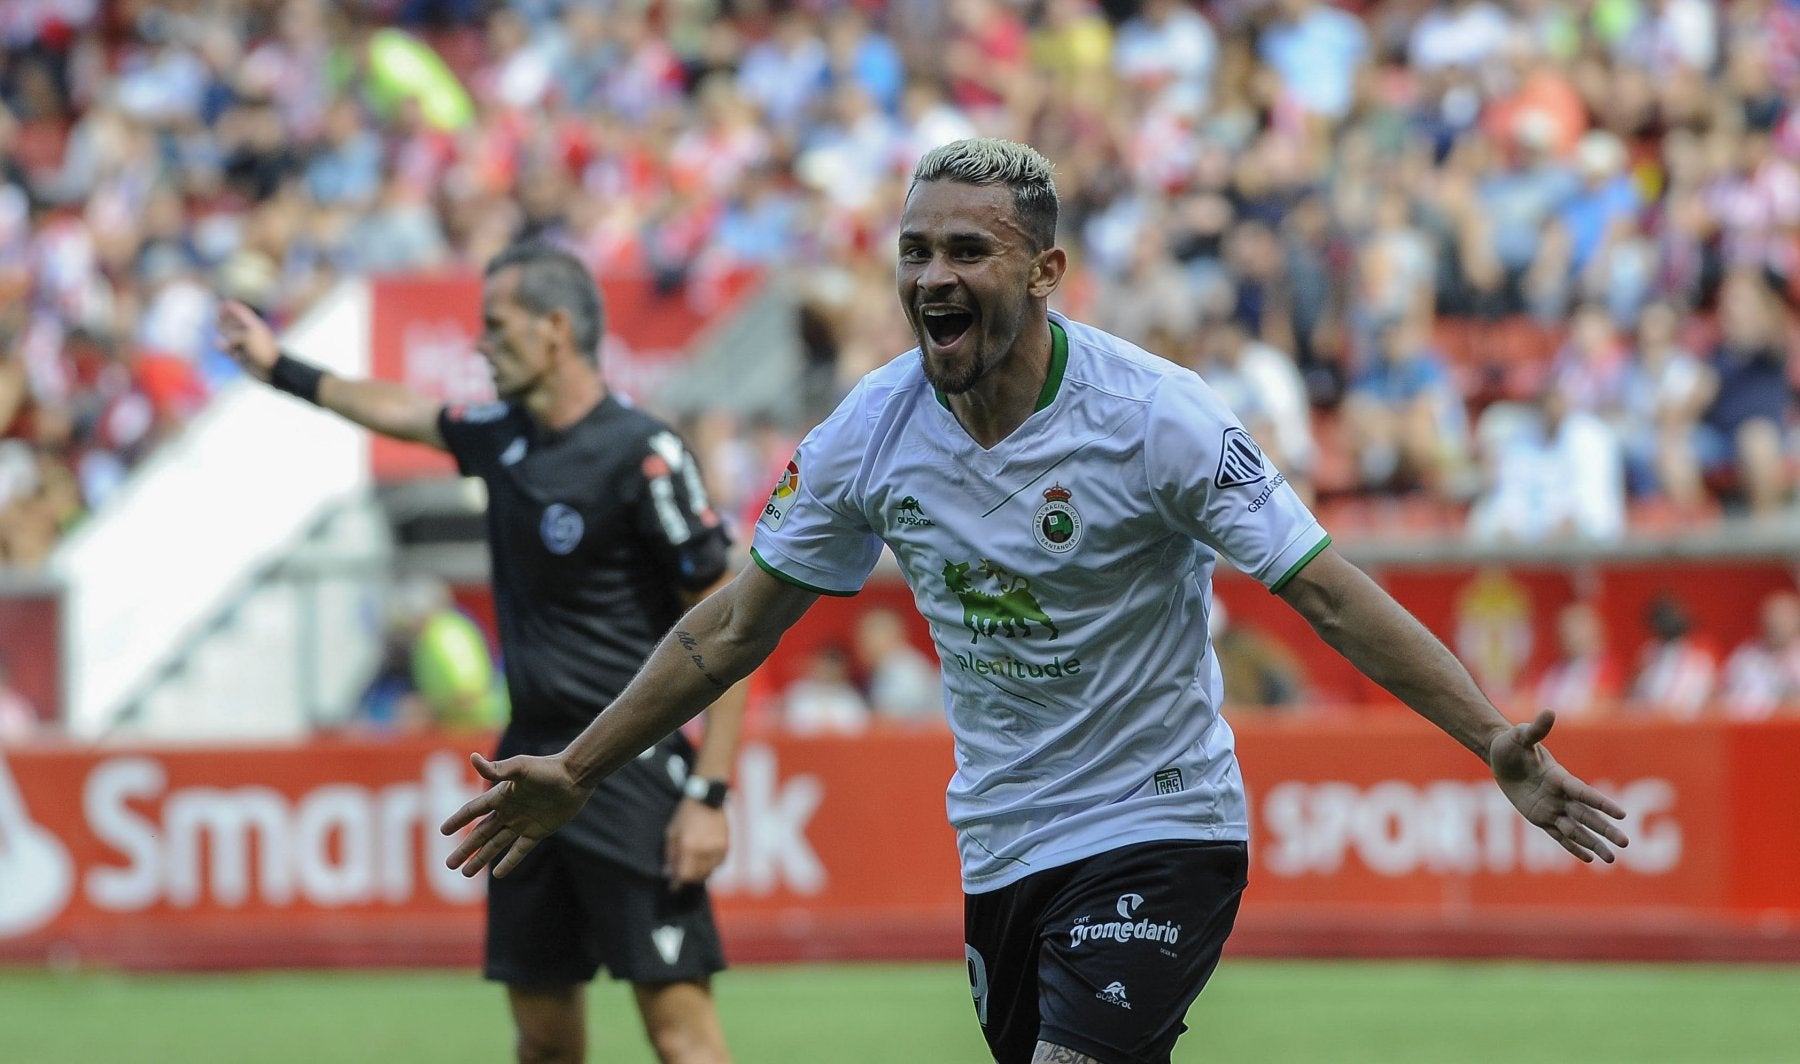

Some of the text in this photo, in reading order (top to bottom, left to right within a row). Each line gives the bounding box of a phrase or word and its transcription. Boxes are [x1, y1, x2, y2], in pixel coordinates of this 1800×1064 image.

[1045, 503, 1070, 512] RACING
[1041, 538, 1077, 551] SANTANDER
[954, 650, 1081, 678] plenitude
